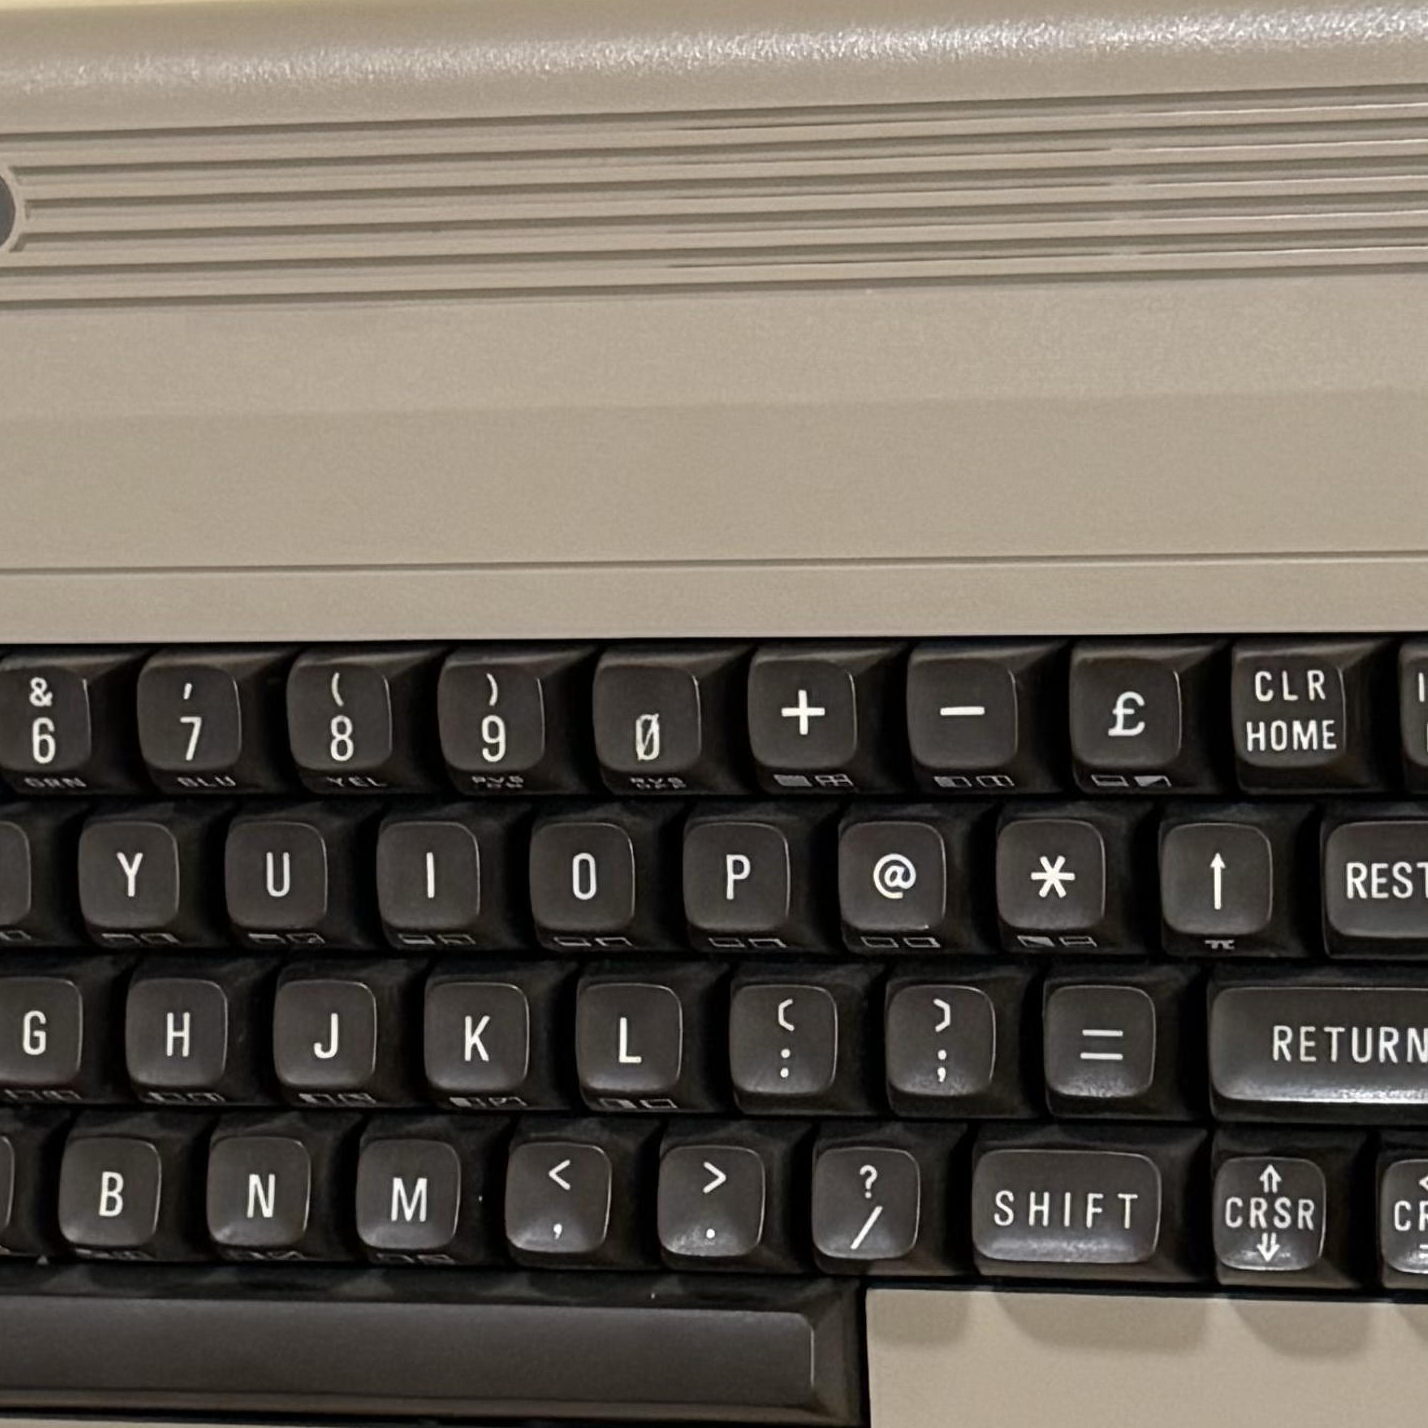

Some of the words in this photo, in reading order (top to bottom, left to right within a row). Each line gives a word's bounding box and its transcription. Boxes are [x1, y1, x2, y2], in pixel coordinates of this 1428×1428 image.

[29, 676, 53, 707] &
[331, 672, 344, 707] (
[486, 673, 498, 706] )
[1254, 669, 1326, 702] CLR
[781, 689, 826, 735] +
[1108, 691, 1146, 737] £
[32, 717, 56, 764] 6
[180, 716, 202, 761] 7
[330, 715, 354, 762] 8
[481, 714, 506, 763] 9
[1246, 719, 1337, 752] HOME
[177, 777, 236, 789] BLU
[326, 777, 388, 789] YEL
[116, 852, 143, 897] Y
[266, 851, 291, 898] U
[426, 852, 435, 899] I
[572, 852, 597, 901] O
[726, 854, 751, 900] P
[872, 853, 917, 900] @
[22, 1010, 47, 1056] G
[166, 1012, 191, 1057] H
[313, 1013, 339, 1059] J
[464, 1015, 490, 1062] K
[618, 1017, 642, 1064] L
[1079, 1029, 1124, 1061] =
[780, 1048, 791, 1078] :
[937, 1049, 947, 1083] ;
[98, 1171, 124, 1217] B
[246, 1173, 276, 1218] N
[548, 1159, 571, 1191] <
[703, 1161, 727, 1194] >
[859, 1164, 878, 1199] ?
[390, 1177, 428, 1222] M
[993, 1190, 1139, 1229] SHIFT
[1225, 1196, 1315, 1230] CRSR
[553, 1223, 563, 1239] ,
[706, 1228, 716, 1239] .
[849, 1206, 883, 1250] /
